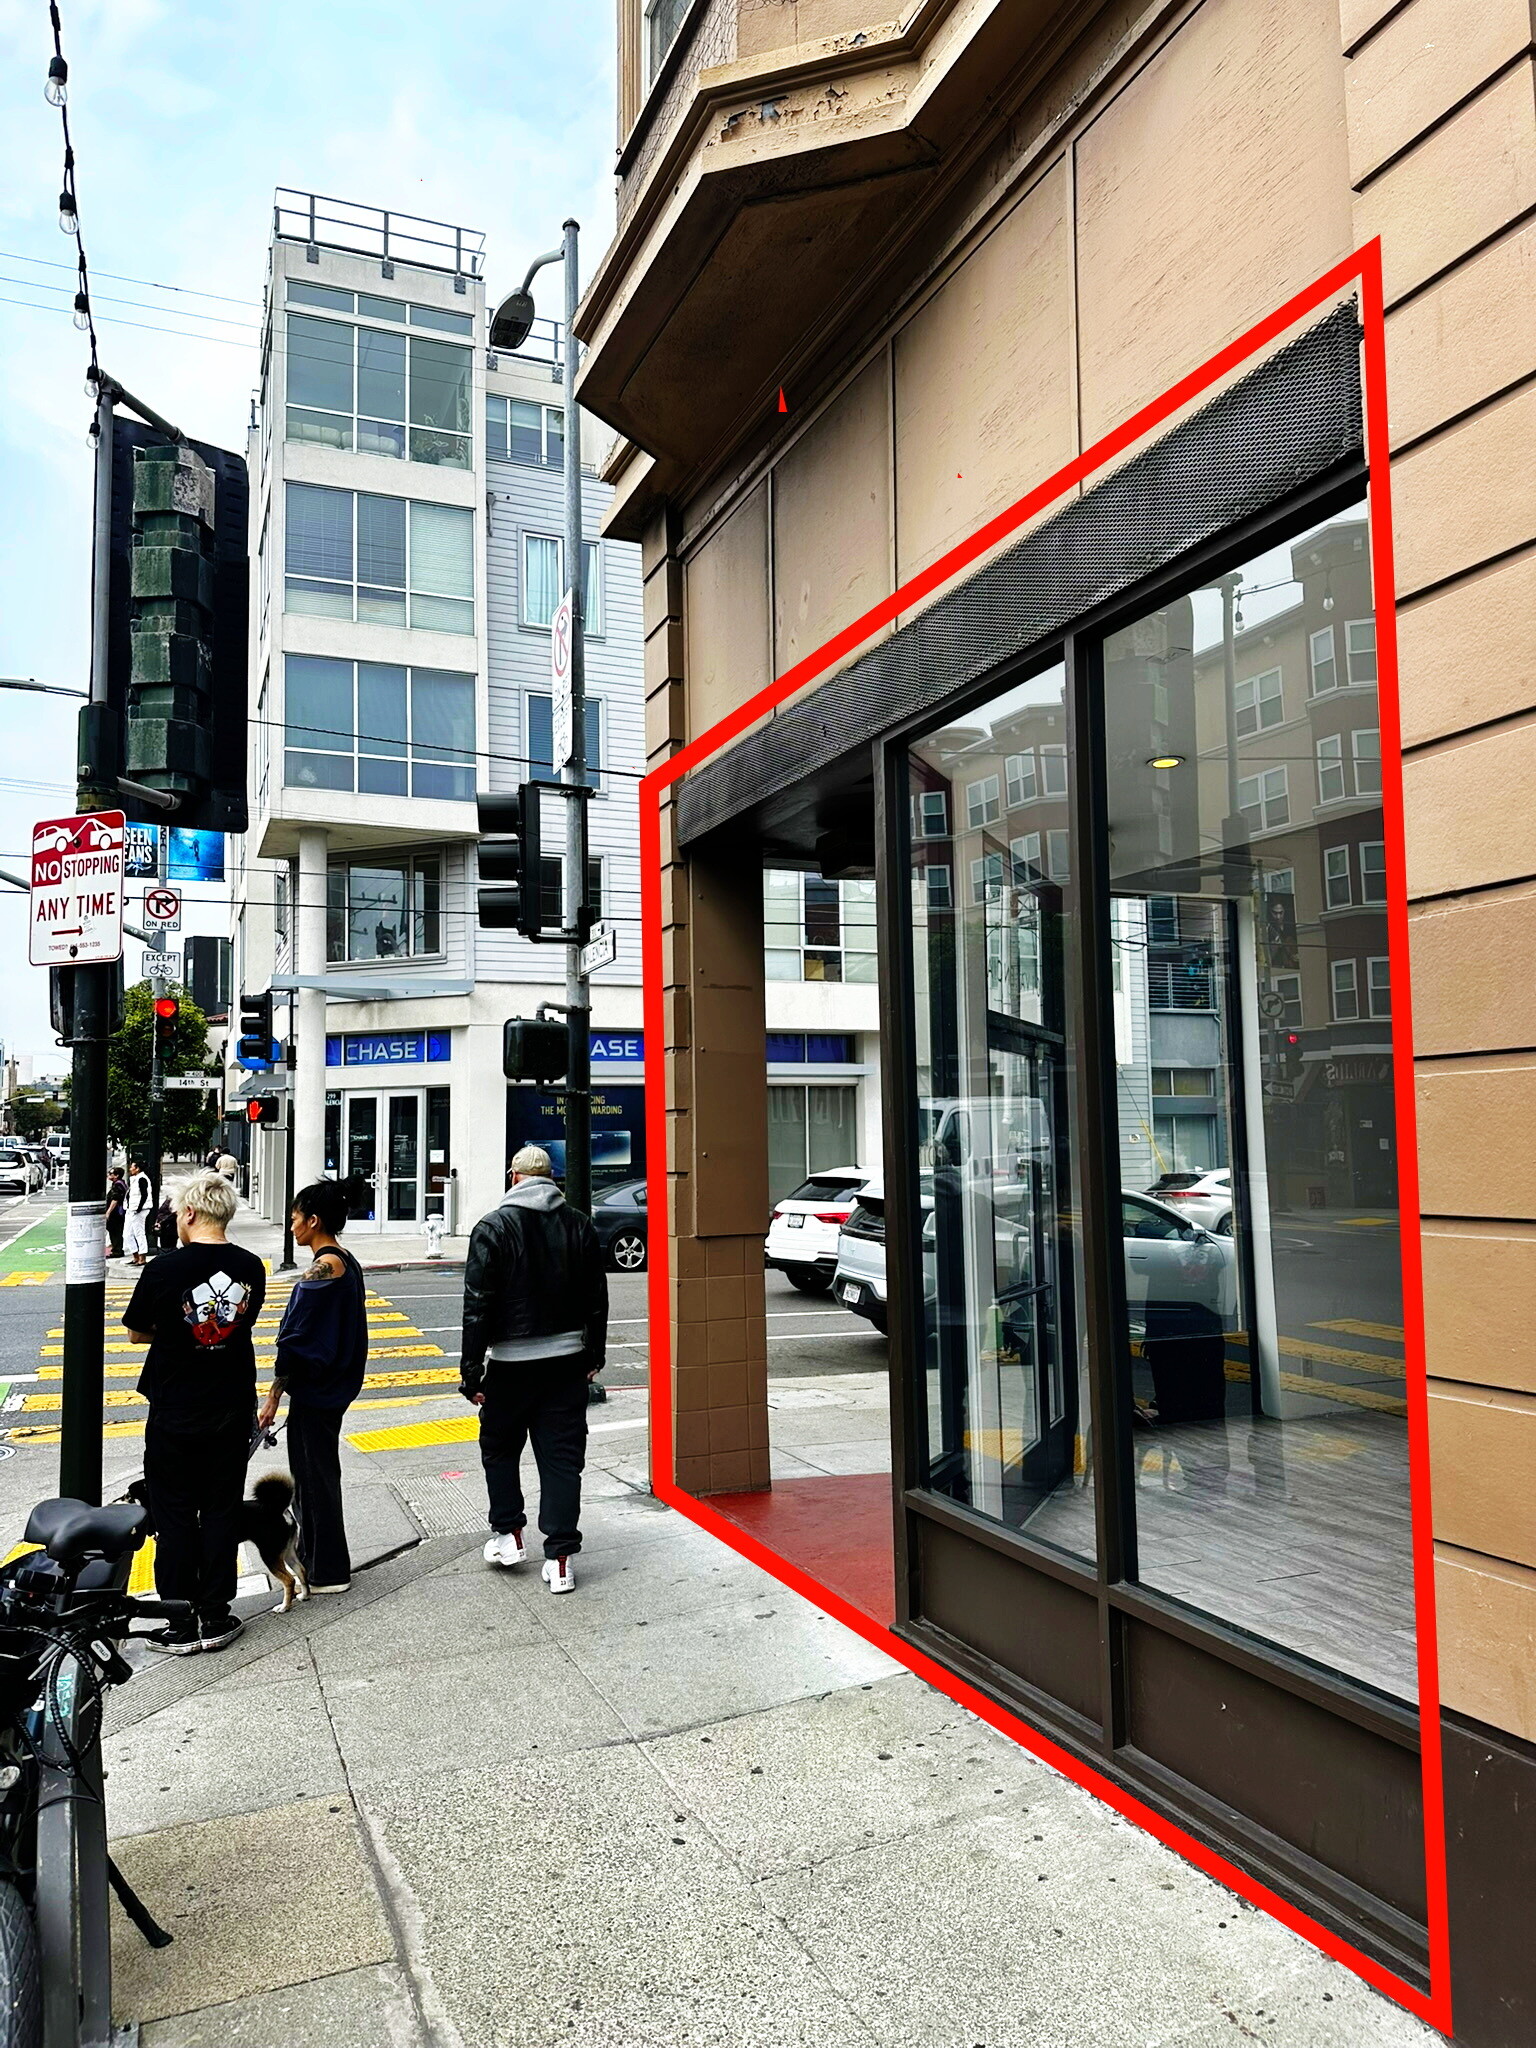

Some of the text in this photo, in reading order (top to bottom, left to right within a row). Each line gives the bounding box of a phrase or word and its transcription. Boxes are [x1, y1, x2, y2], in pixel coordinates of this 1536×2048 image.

[125, 827, 153, 845] SEEN
[125, 845, 153, 863] EANS
[34, 854, 120, 883] NO STOPPING
[36, 892, 115, 922] ANY TIME
[70, 941, 101, 949] -553-1235
[145, 954, 177, 962] EXCEPT
[346, 1041, 418, 1060] CHASE
[590, 1039, 639, 1057] ASE
[200, 1079, 209, 1087] St
[541, 1106, 622, 1115] THE MO WARDING
